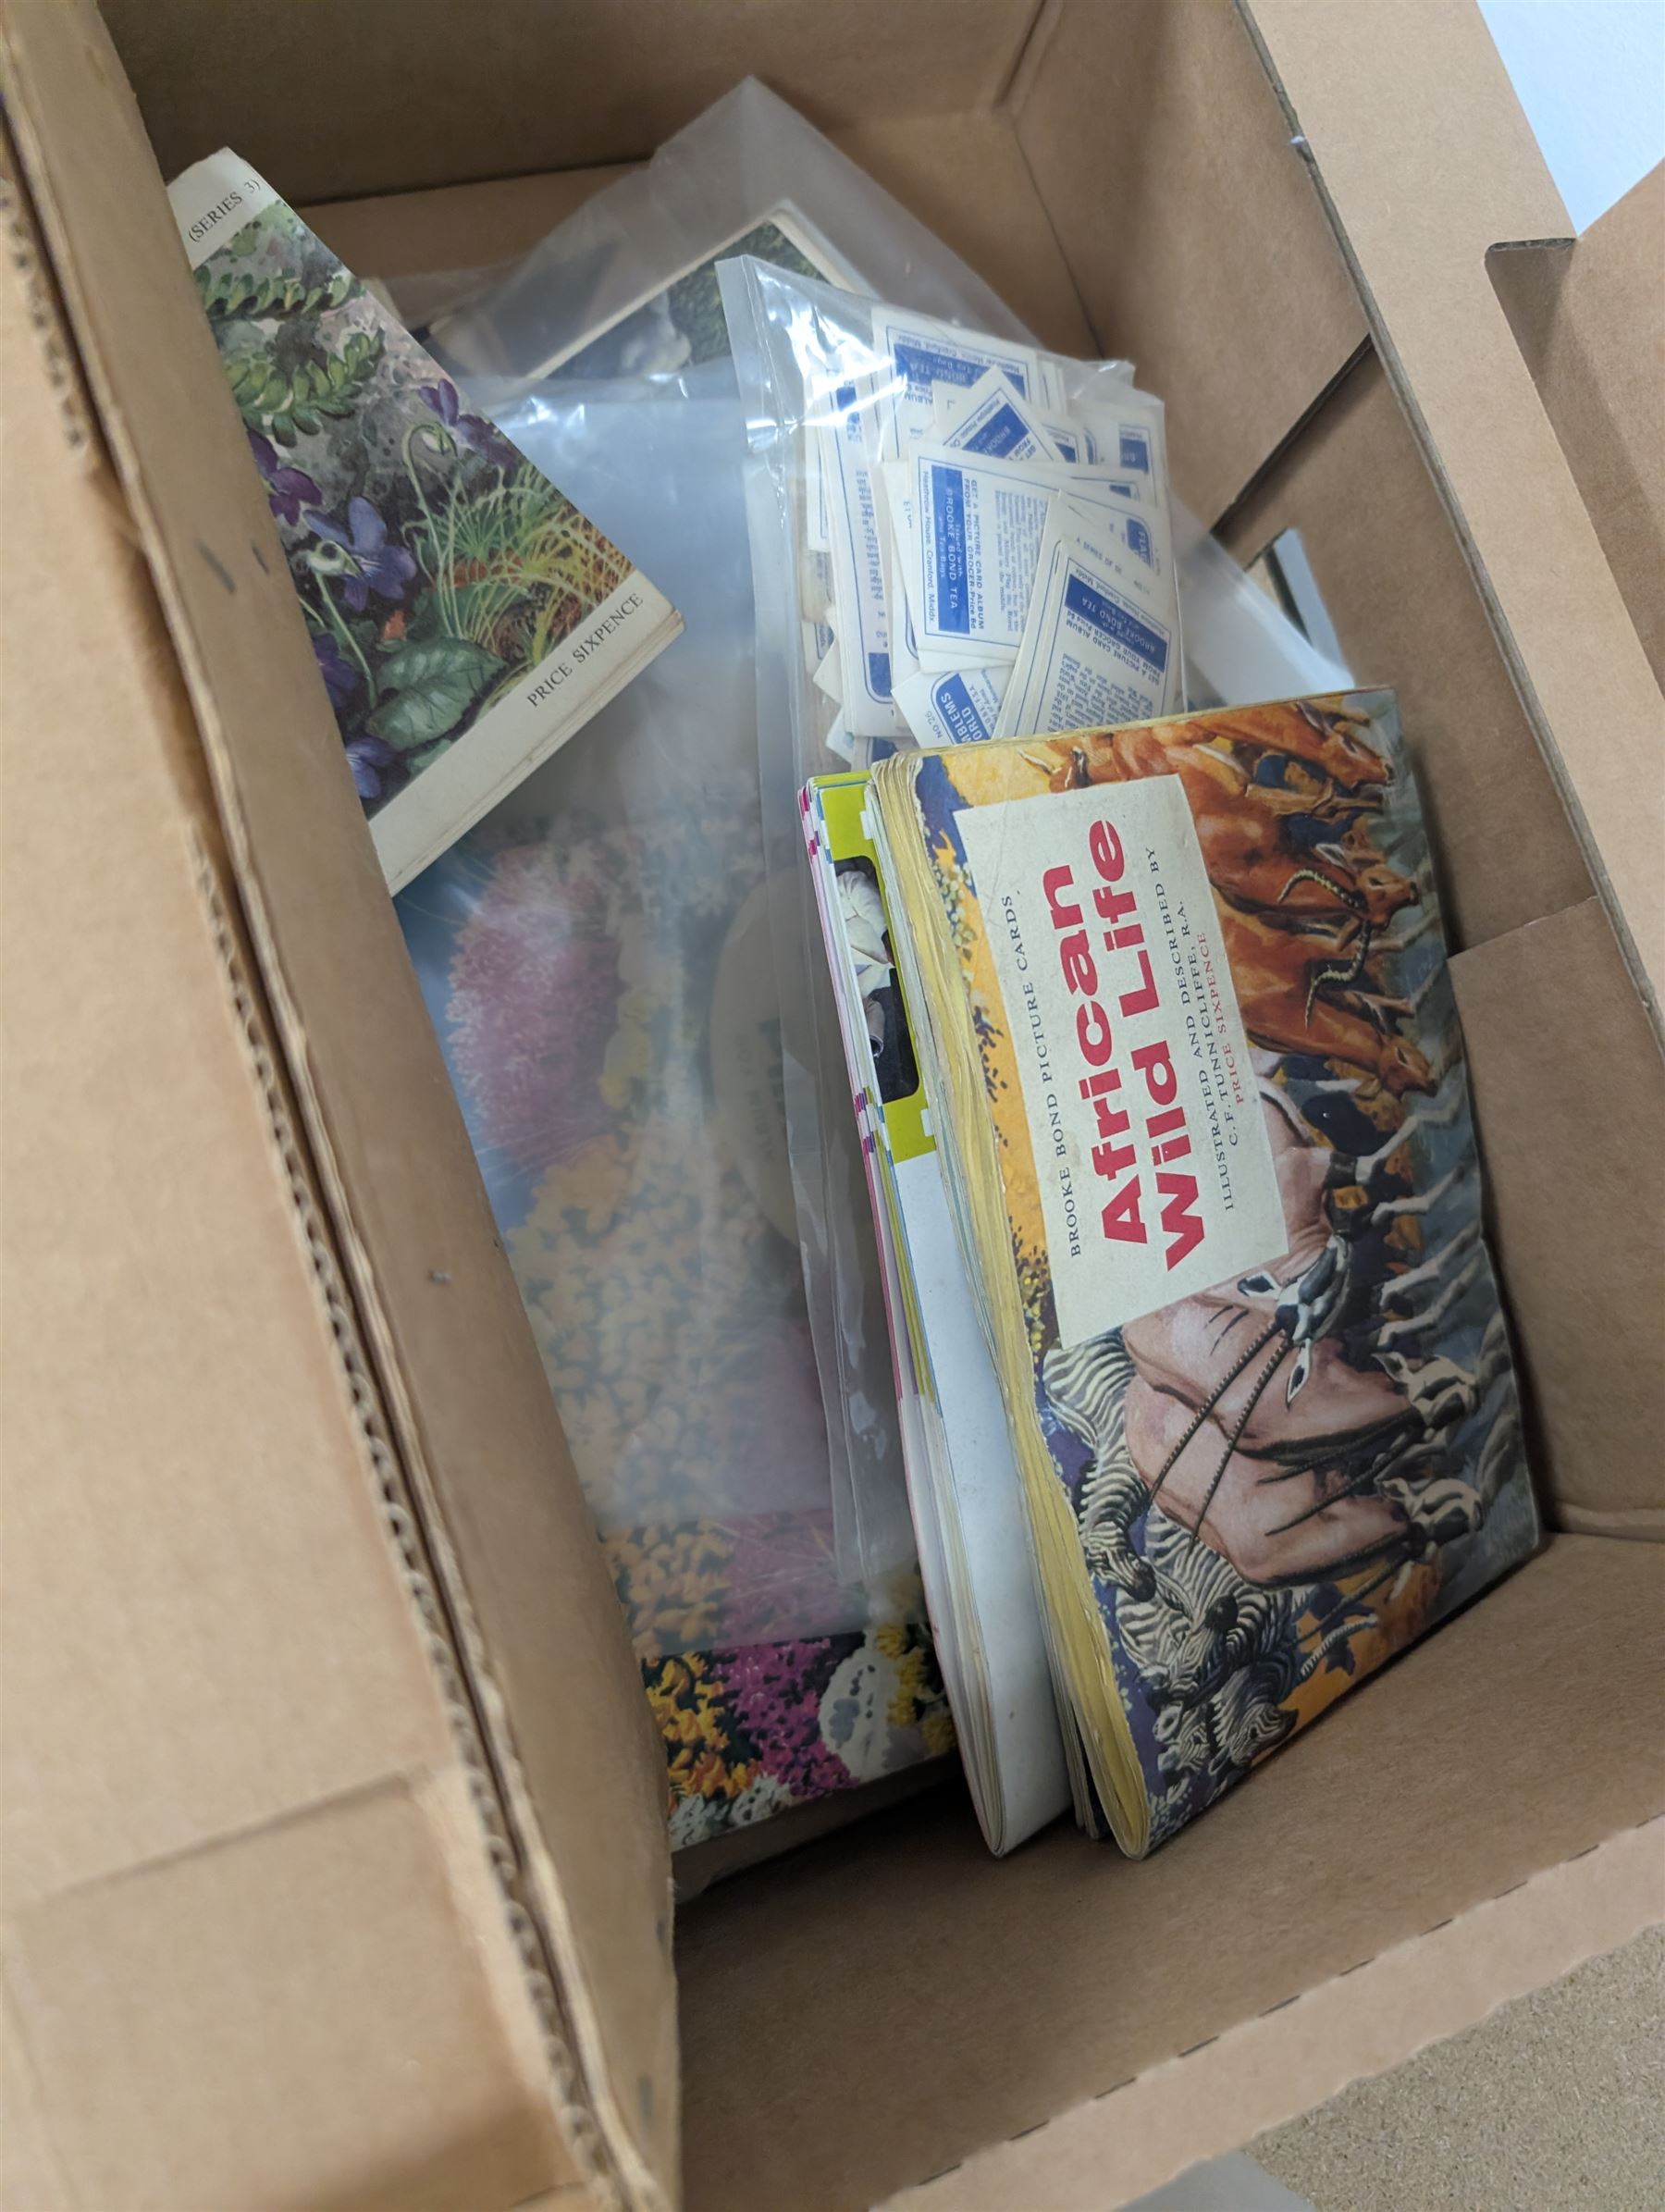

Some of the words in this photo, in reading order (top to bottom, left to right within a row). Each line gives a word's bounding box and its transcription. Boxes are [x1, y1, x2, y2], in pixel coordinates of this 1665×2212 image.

[188, 191, 243, 242] (SERIES
[243, 179, 261, 193] 3)
[944, 488, 955, 538] BROOKE
[972, 513, 980, 556] PICTURE
[946, 544, 956, 581] BOND
[974, 560, 982, 588] CARD
[948, 587, 957, 610] TEA
[976, 592, 984, 630] ALBUM
[1081, 597, 1095, 612] TEA
[1100, 609, 1121, 629] BOND
[526, 662, 573, 708] PRICE
[572, 593, 644, 663] SIXPENCE
[1066, 619, 1090, 639] ALBUM
[1092, 636, 1111, 653] CARD
[1126, 629, 1155, 653] BROOKE
[1112, 649, 1140, 672] PICTURE
[1122, 649, 1141, 663] YOUR
[940, 692, 972, 742] MBLEMS
[961, 707, 983, 741] ORLD
[1145, 846, 1160, 874] BY
[1001, 895, 1029, 972] CARDS
[1088, 819, 1160, 1018] Life
[1177, 900, 1191, 937] R.A.
[1154, 882, 1191, 1006] DESCRIBED
[1195, 932, 1227, 1034] SIXPENCE
[1023, 982, 1054, 1084] PICTURE
[1042, 863, 1149, 1245] African
[1185, 1015, 1203, 1059] AND
[1221, 1042, 1244, 1105] PRICE
[1046, 1093, 1067, 1158] BOND
[1201, 1069, 1236, 1211] ILLUSTRATED
[1129, 1039, 1206, 1272] Wild
[1058, 1166, 1082, 1258] BROOKE
